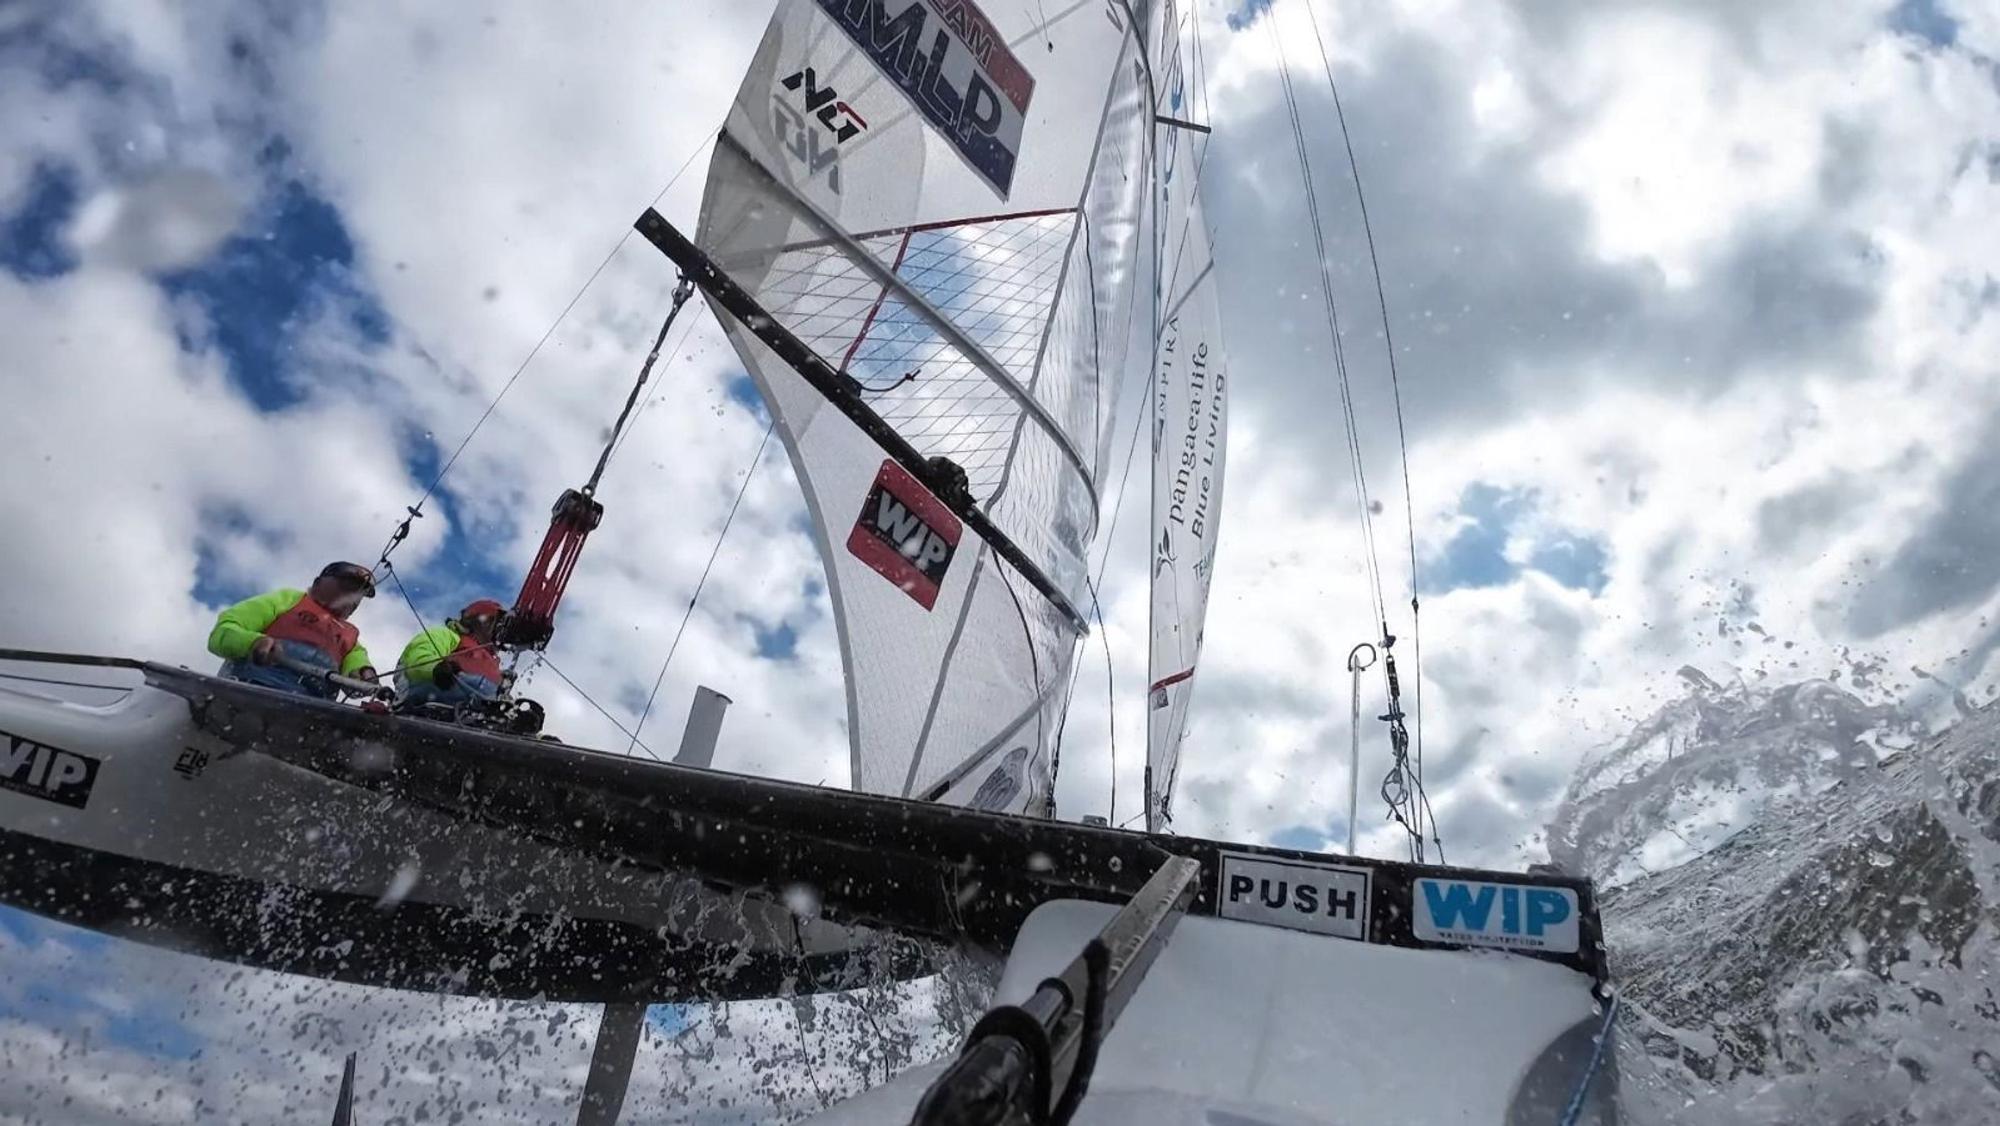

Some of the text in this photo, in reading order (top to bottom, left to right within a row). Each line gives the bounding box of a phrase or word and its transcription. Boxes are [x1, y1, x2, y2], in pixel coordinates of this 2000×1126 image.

[844, 0, 1002, 145] MLP
[1192, 475, 1211, 540] Blue
[1203, 373, 1226, 467] Living
[876, 489, 948, 572] WIP
[1229, 874, 1357, 919] PUSH
[1420, 880, 1571, 937] WIP
